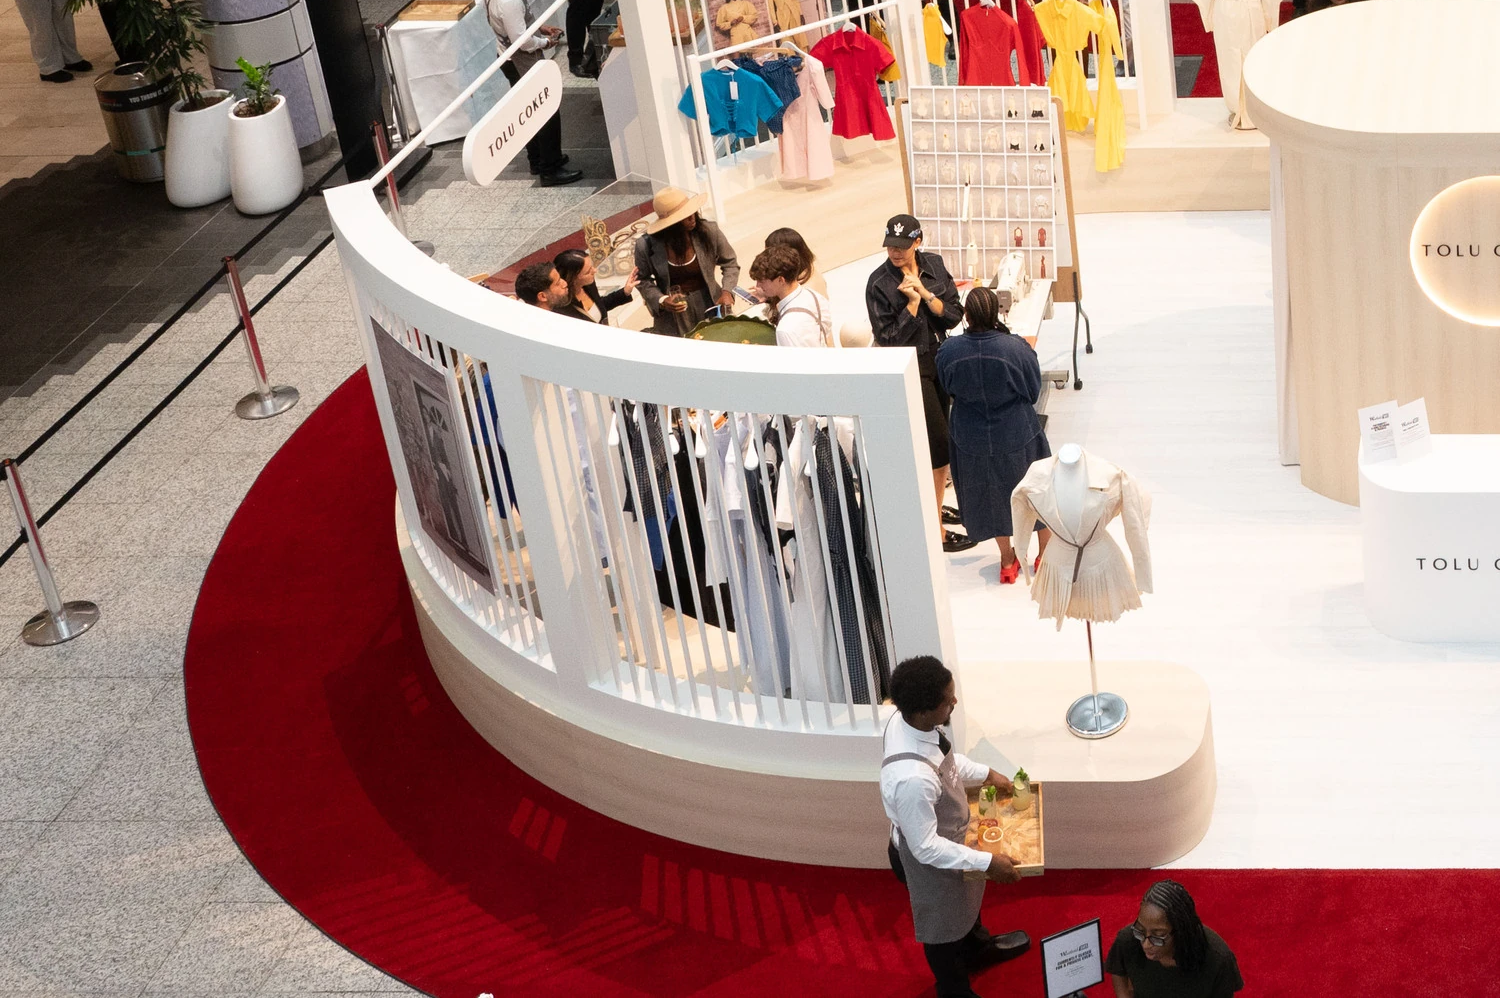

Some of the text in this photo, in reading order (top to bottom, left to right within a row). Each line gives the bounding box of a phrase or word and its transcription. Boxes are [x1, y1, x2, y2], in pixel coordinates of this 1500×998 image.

[488, 86, 551, 157] TOLU COKER
[1421, 243, 1481, 258] TOLU
[1415, 557, 1479, 571] TOLU
